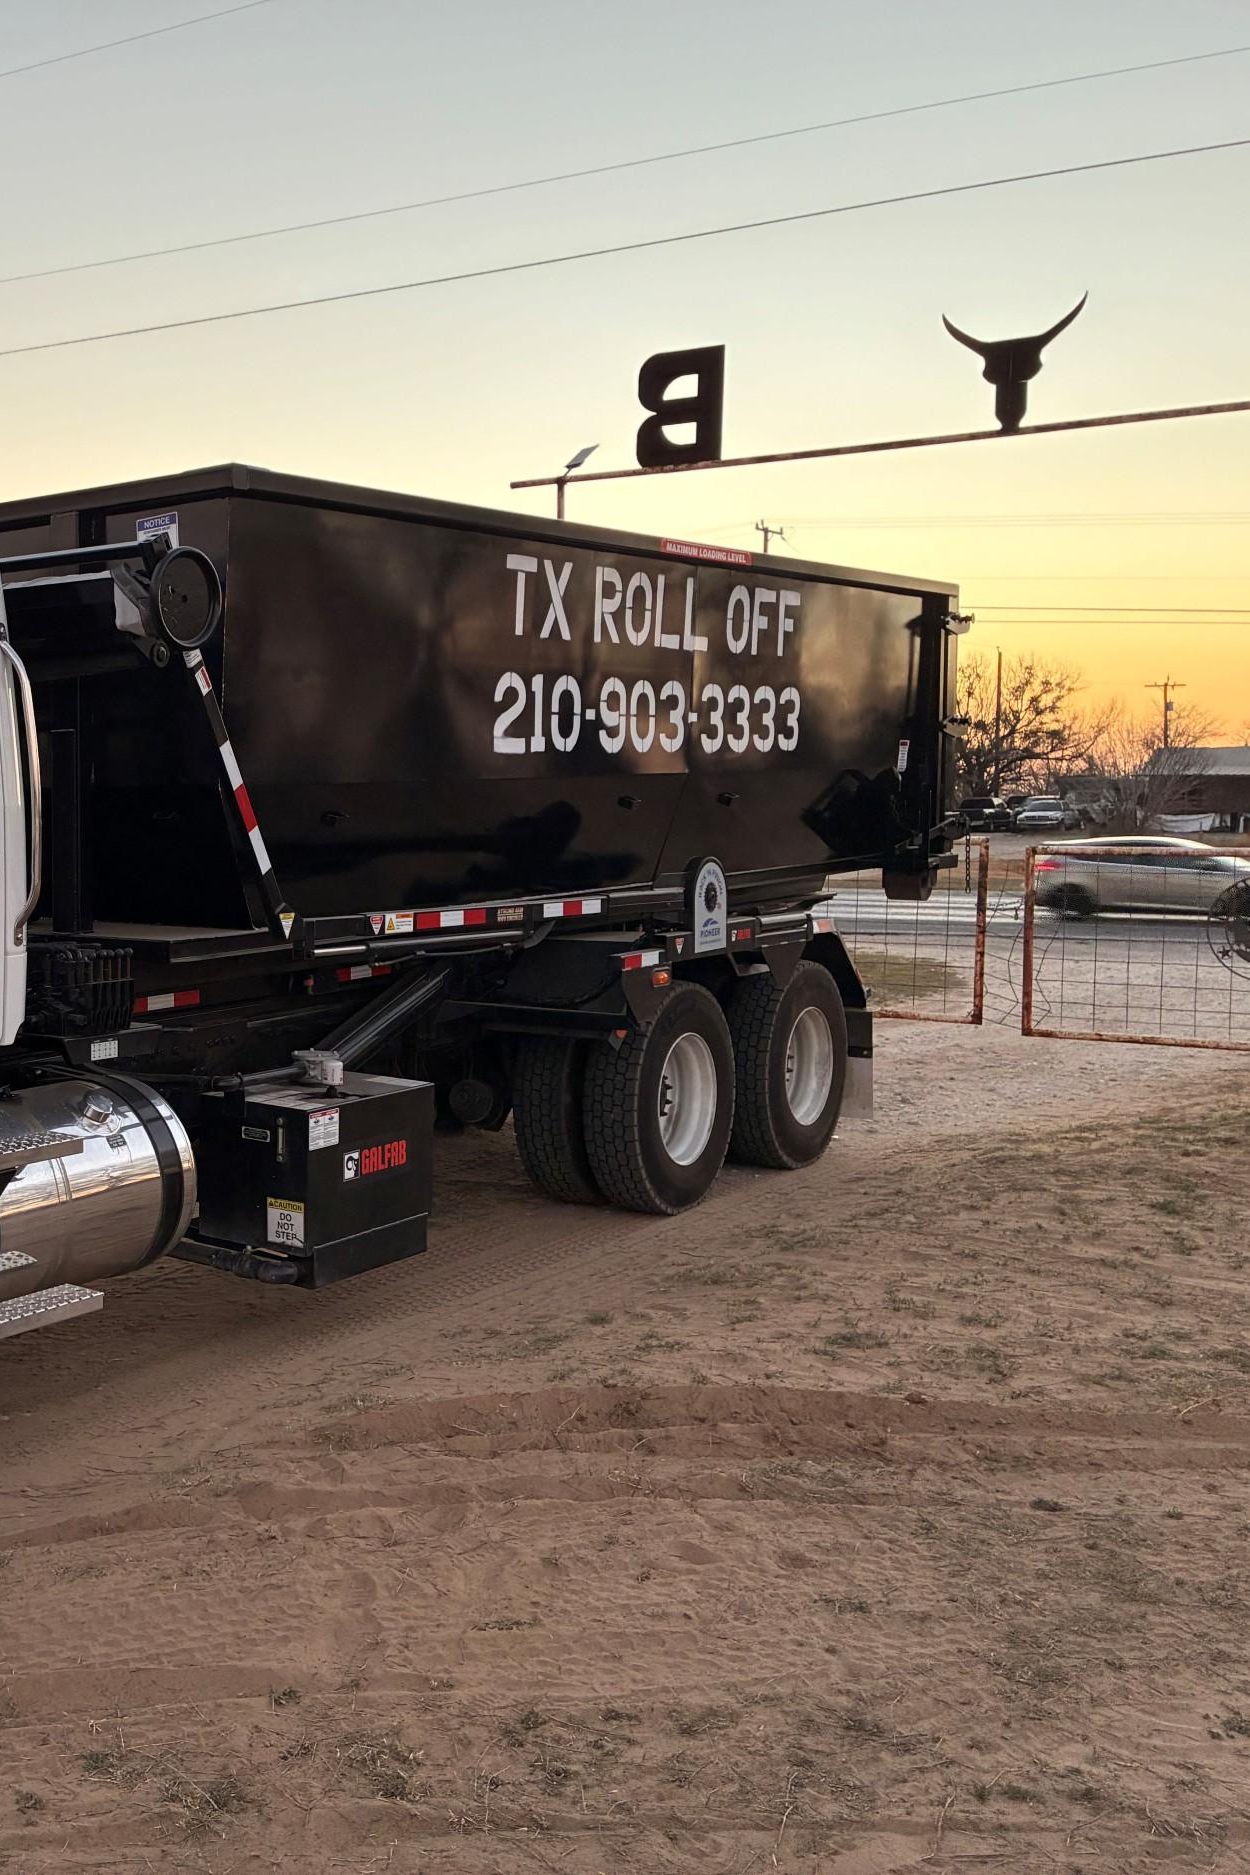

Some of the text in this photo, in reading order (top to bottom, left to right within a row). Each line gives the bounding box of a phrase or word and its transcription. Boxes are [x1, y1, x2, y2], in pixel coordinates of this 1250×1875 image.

[144, 516, 171, 529] NOTICE
[666, 542, 747, 563] MAXIMUM LOADING LEVEL
[506, 553, 801, 657] TX ROLL OFF
[493, 671, 801, 754] 210-903-3333
[361, 1139, 407, 1175] GALFAB
[273, 1201, 303, 1211] CAUTION
[280, 1213, 292, 1222] DO
[277, 1221, 295, 1231] NOT
[275, 1230, 297, 1241] STEP
